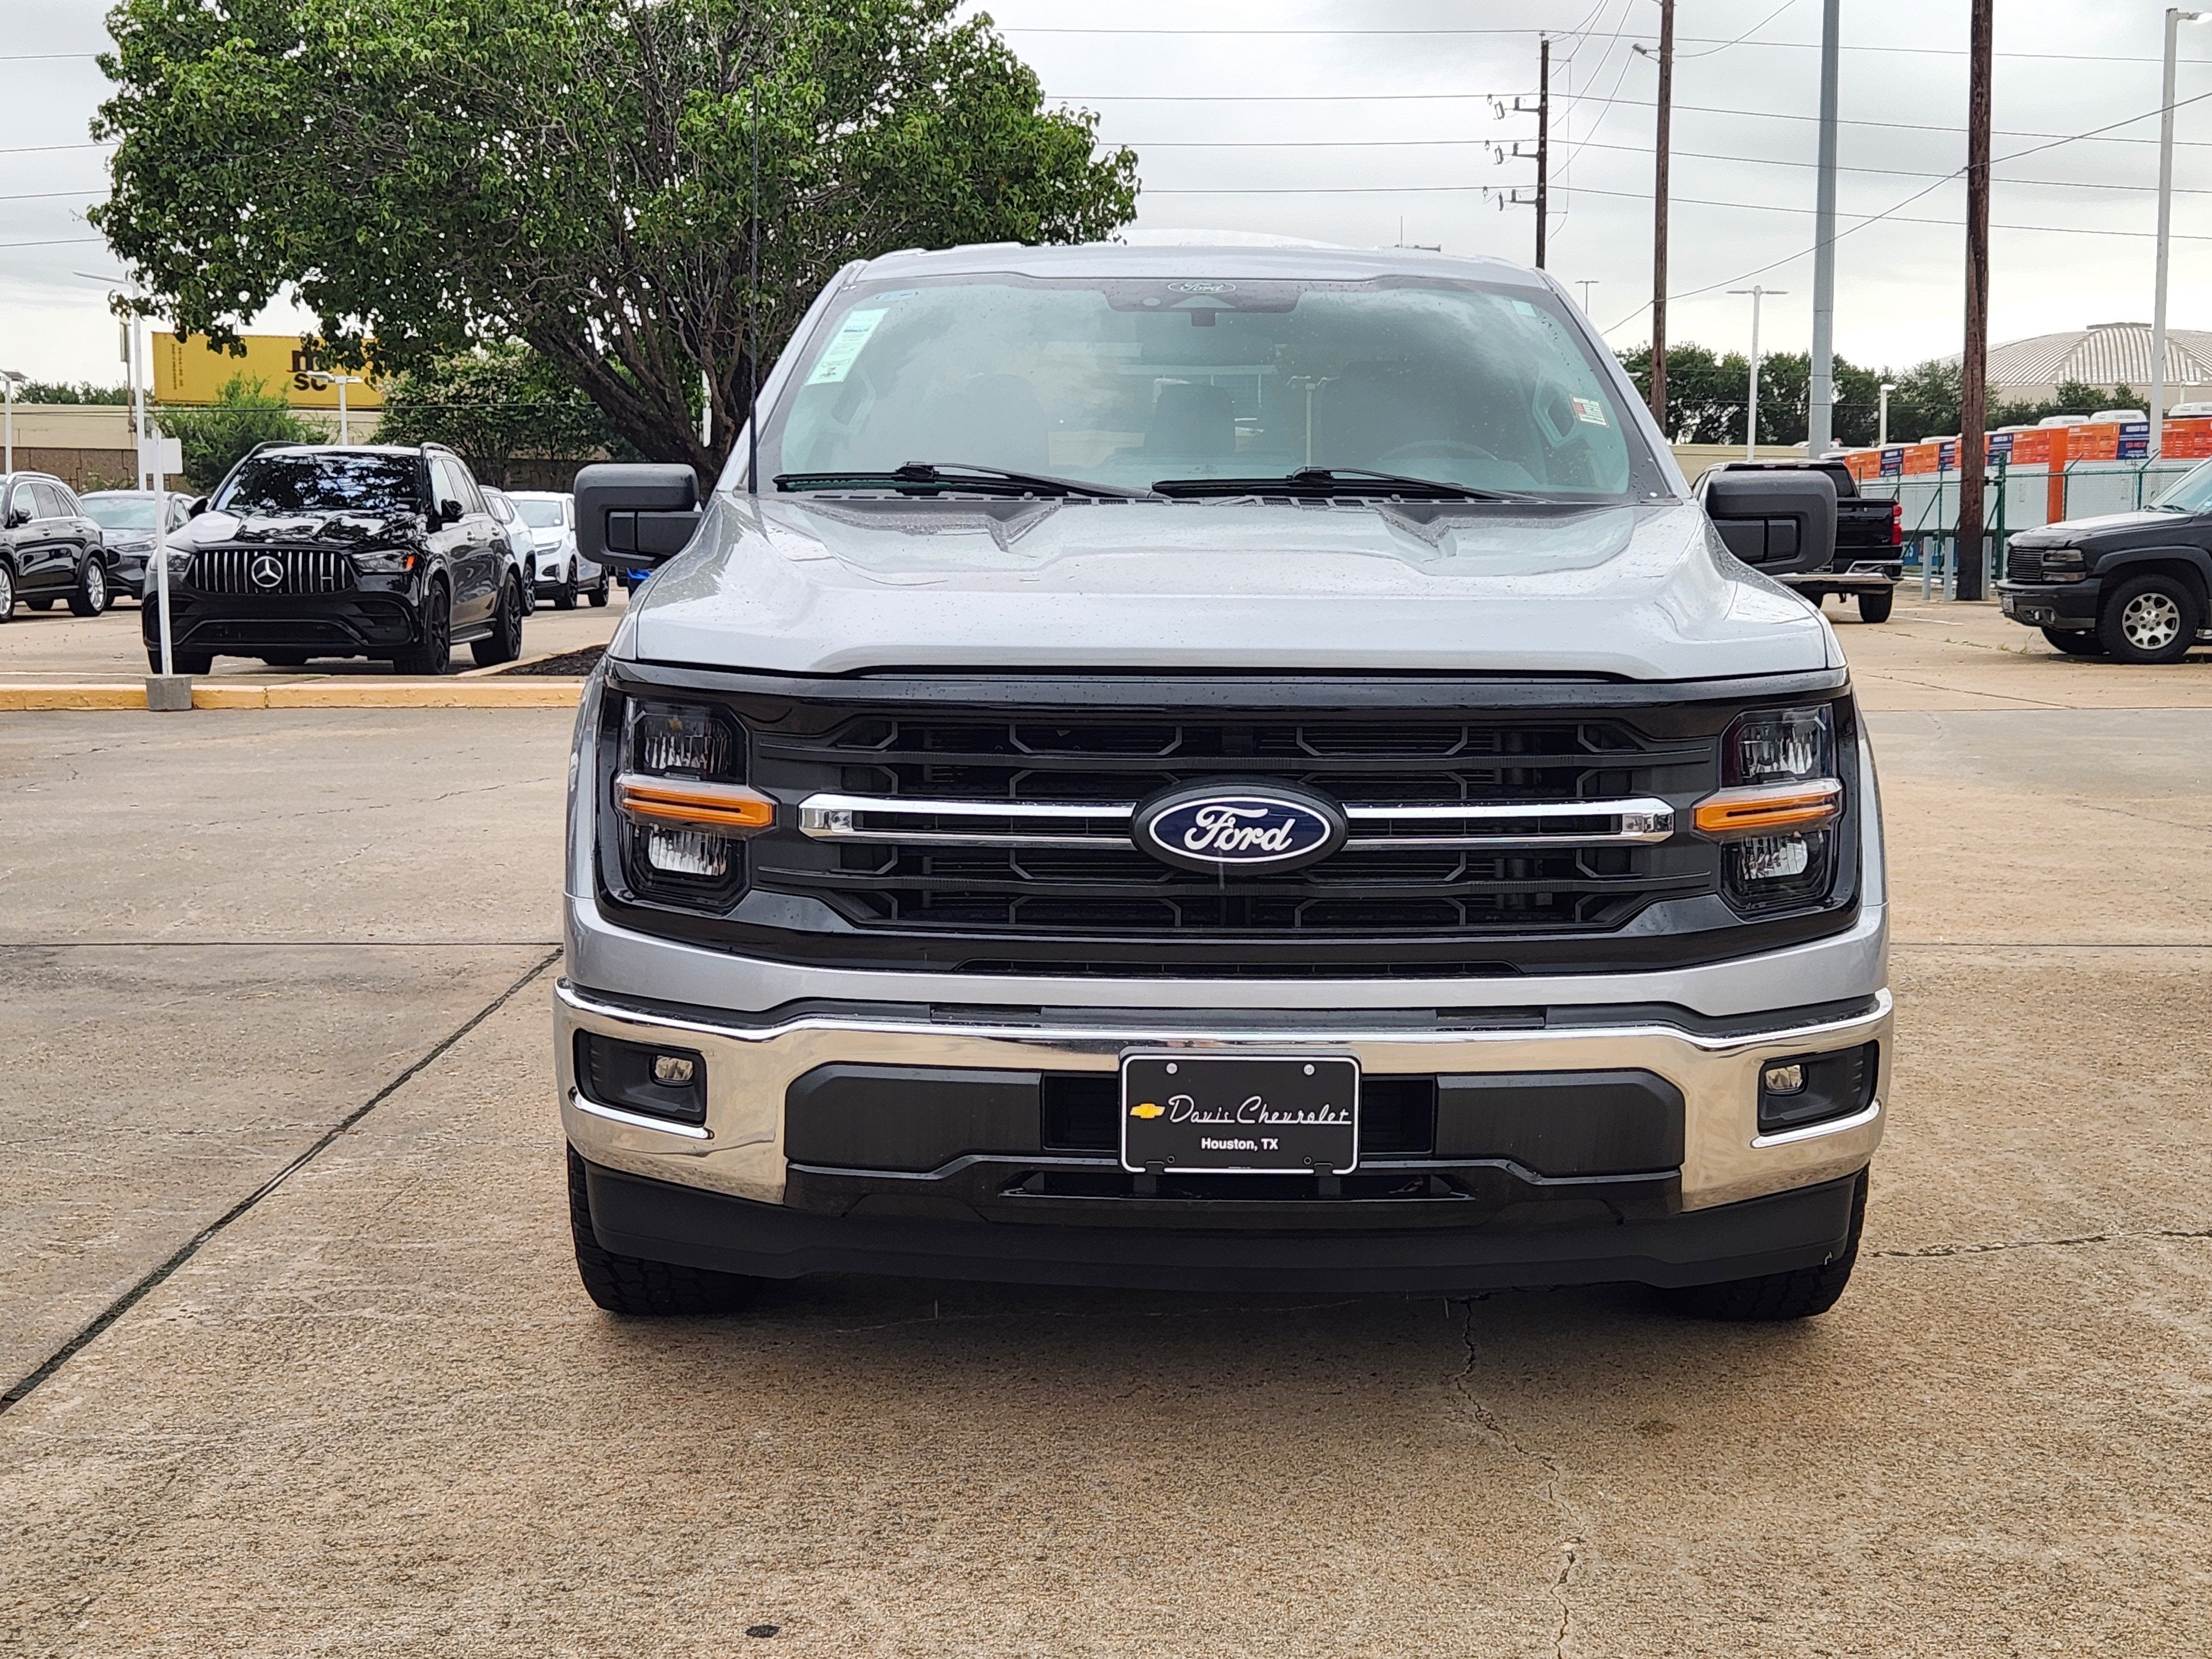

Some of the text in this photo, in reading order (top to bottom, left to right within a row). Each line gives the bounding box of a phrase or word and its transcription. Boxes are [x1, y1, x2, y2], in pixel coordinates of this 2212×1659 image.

[1180, 283, 1224, 291] Ford
[1184, 805, 1295, 851] Ford
[1168, 1094, 1353, 1125] Davis Chevrolet
[1201, 1138, 1279, 1151] Houston, TX
